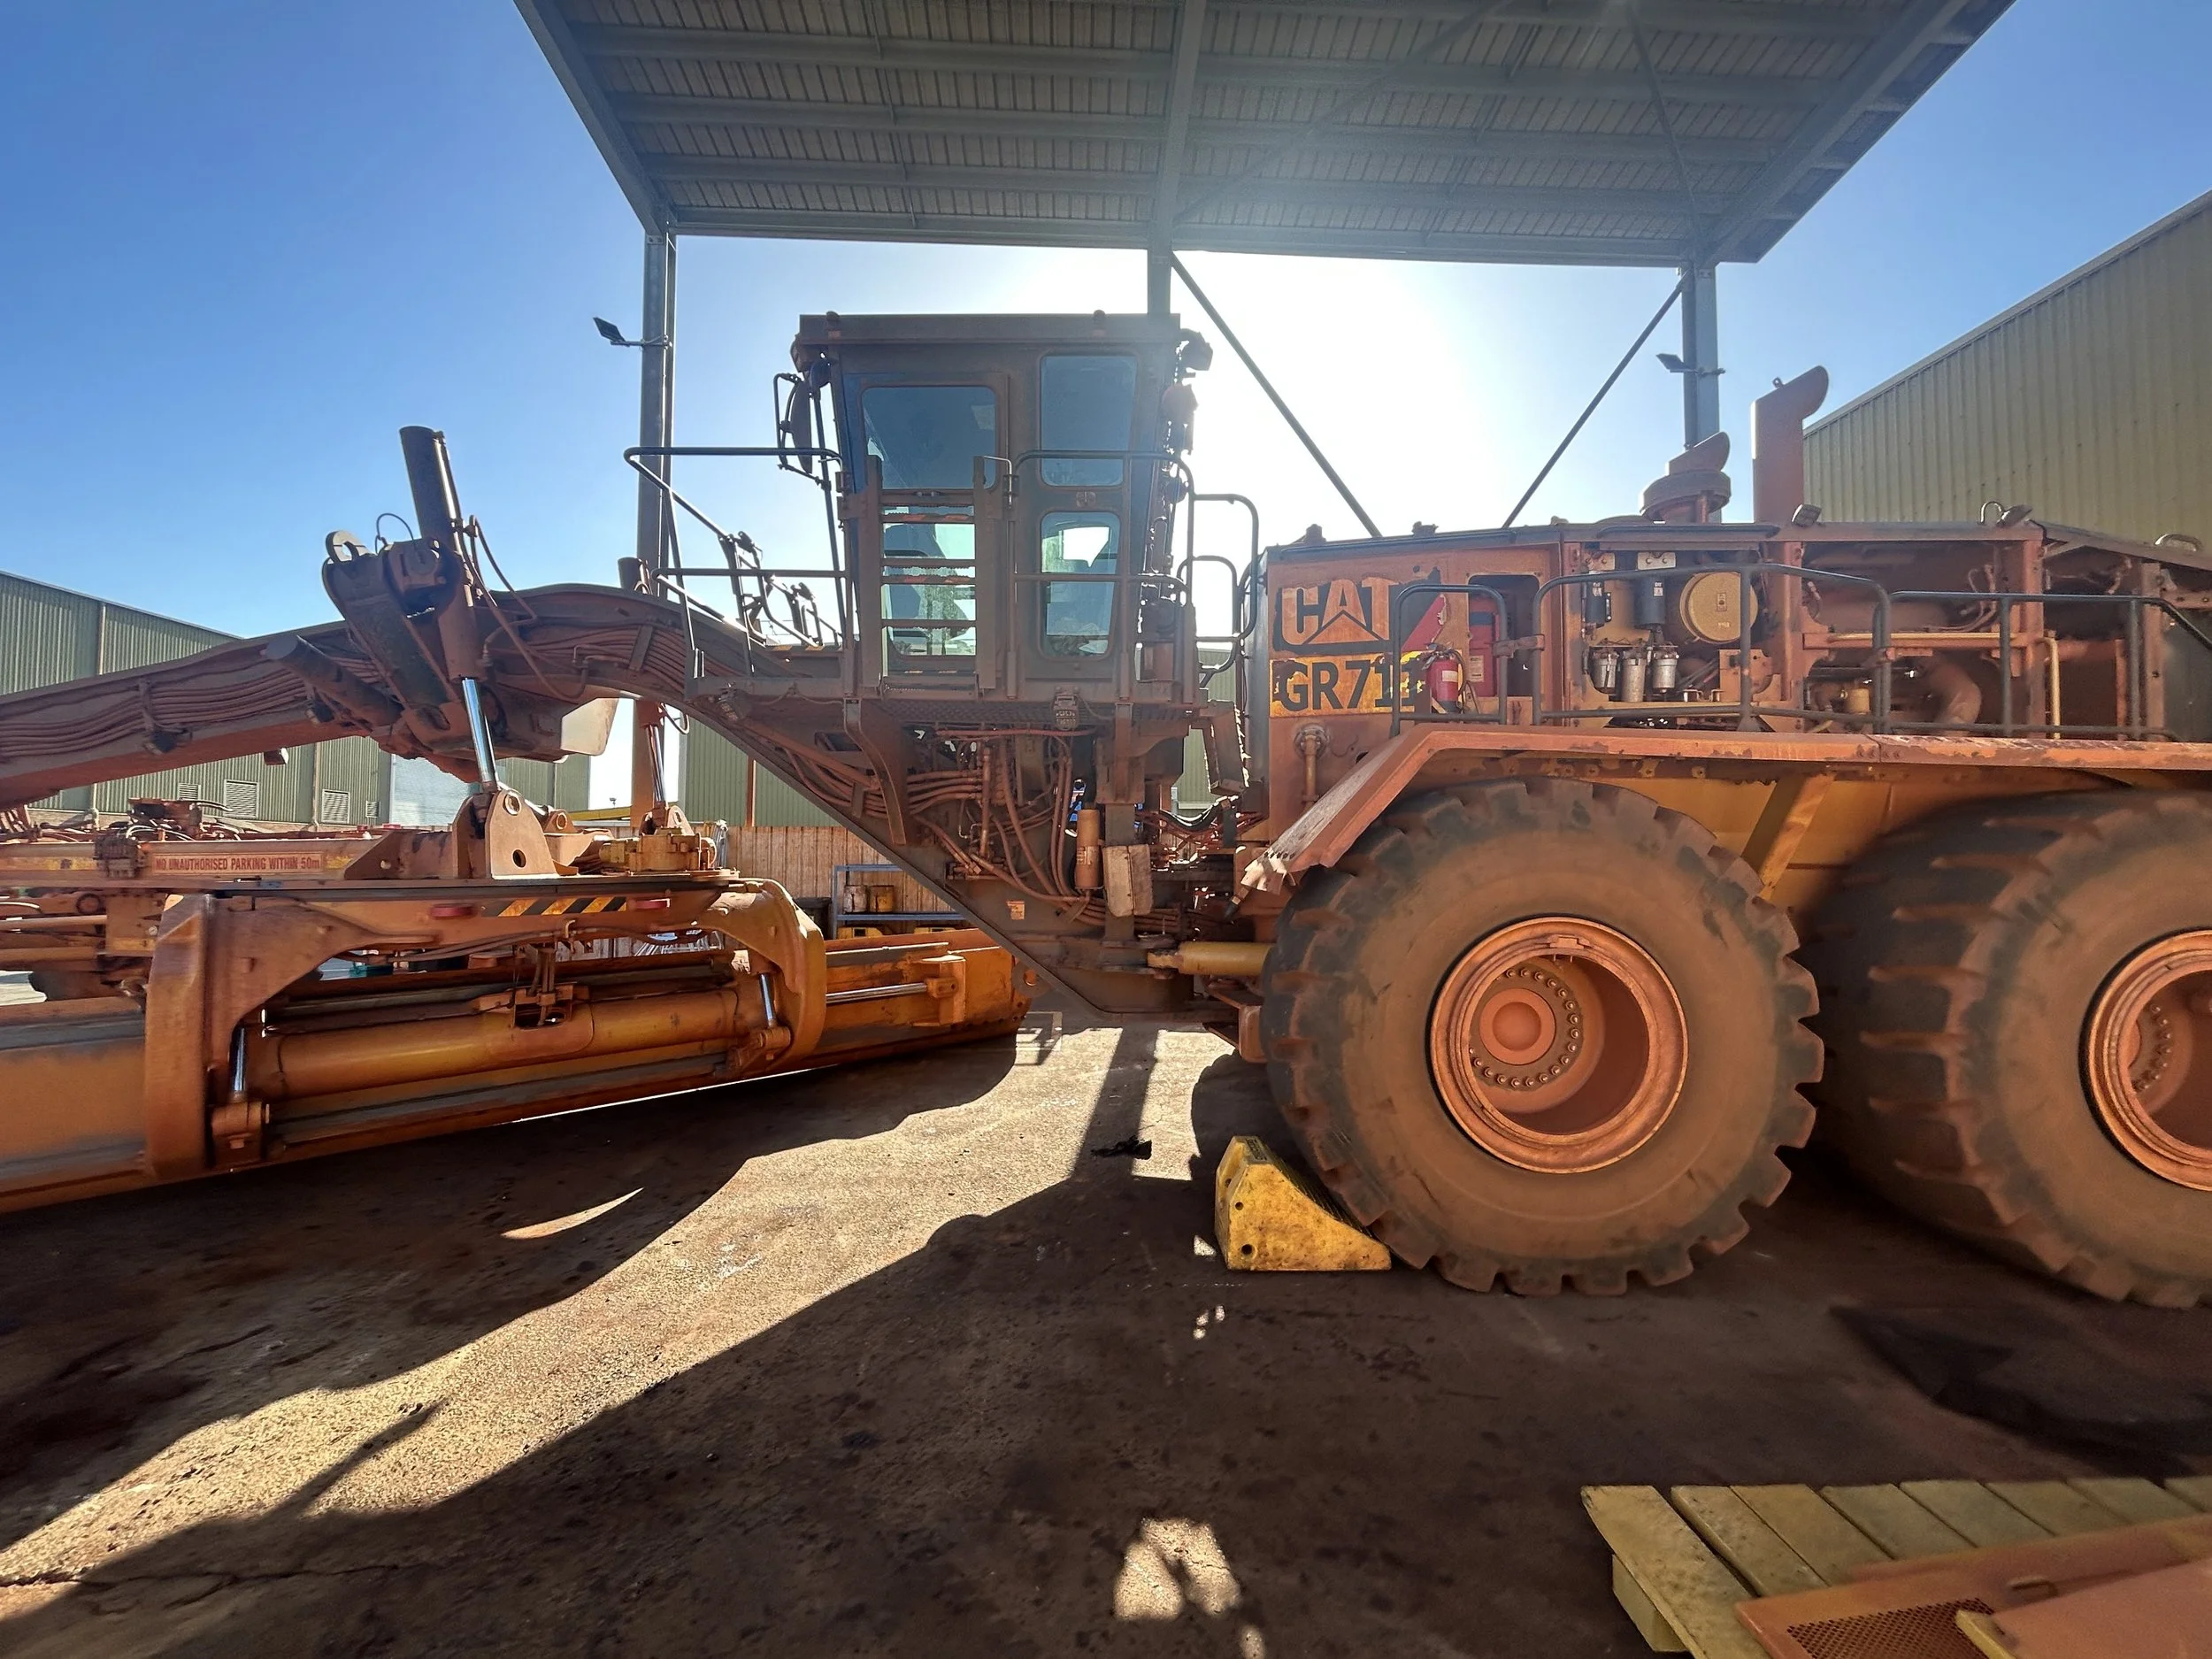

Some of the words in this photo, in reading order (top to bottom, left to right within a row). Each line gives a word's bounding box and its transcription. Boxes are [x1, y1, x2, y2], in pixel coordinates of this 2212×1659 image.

[1281, 577, 1400, 646] CAT
[155, 857, 166, 871] NO
[169, 857, 228, 871] UNAUTHORISED
[231, 856, 266, 871] PARKING
[269, 856, 298, 870] WITHIN
[301, 856, 320, 870] 50m
